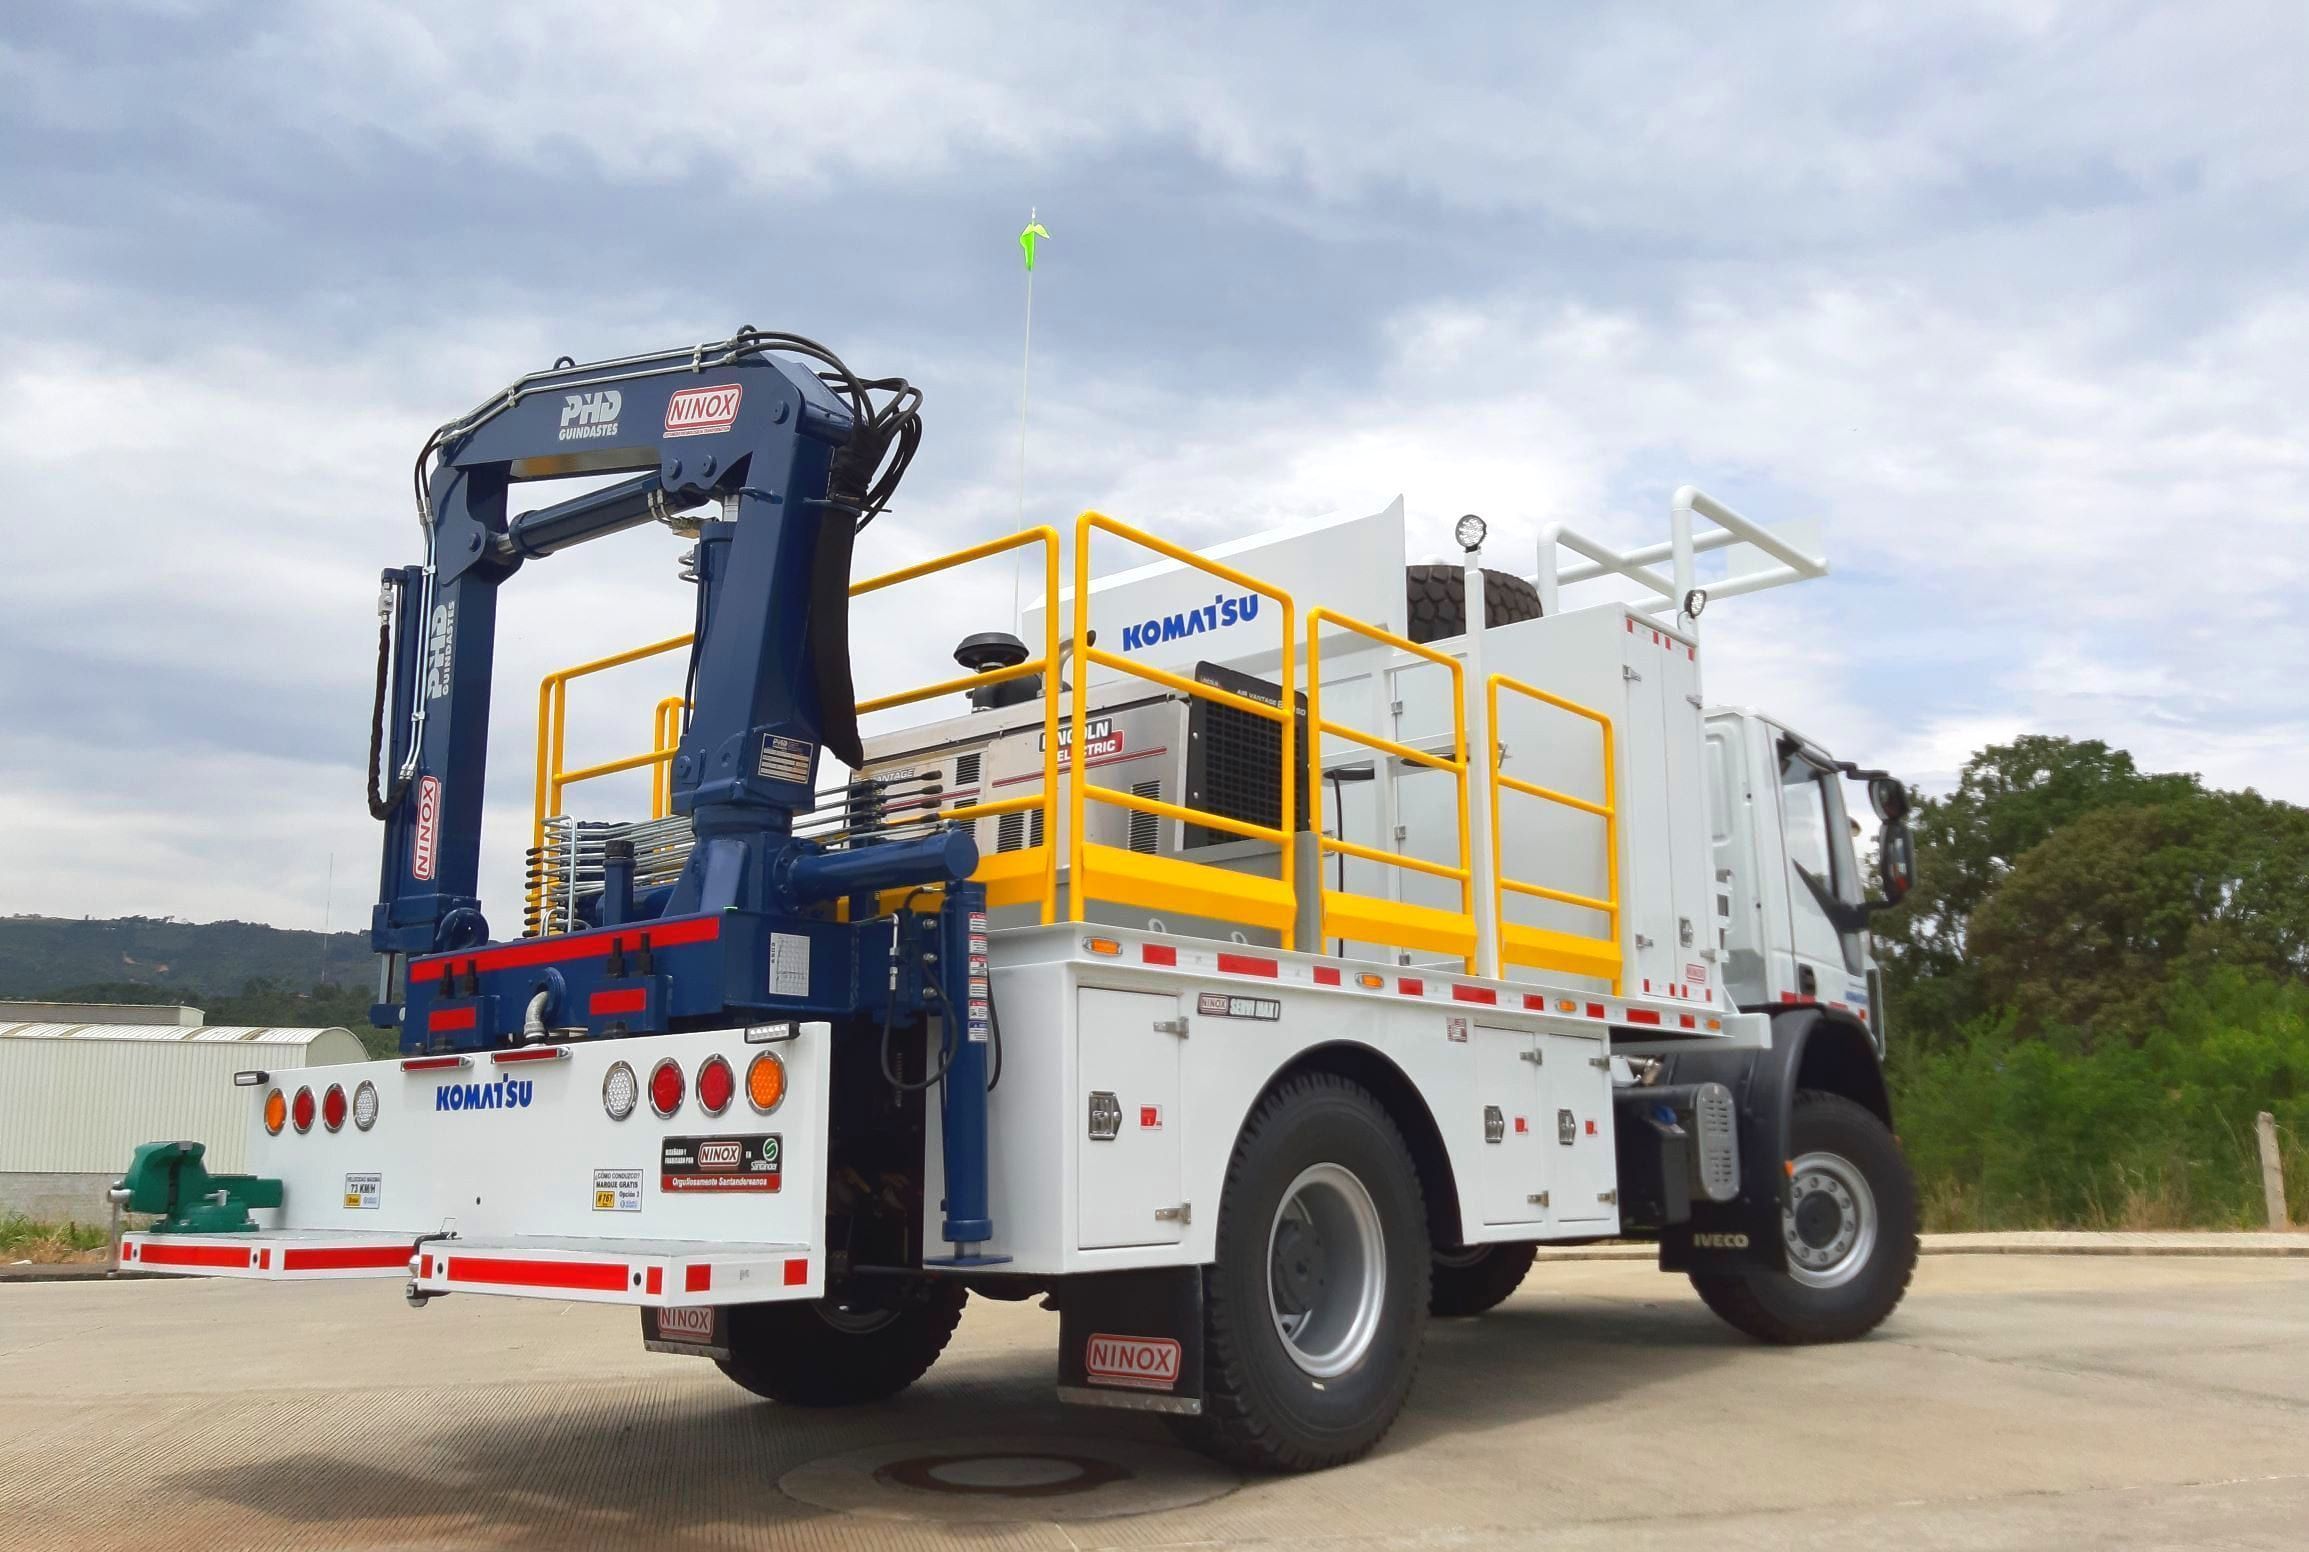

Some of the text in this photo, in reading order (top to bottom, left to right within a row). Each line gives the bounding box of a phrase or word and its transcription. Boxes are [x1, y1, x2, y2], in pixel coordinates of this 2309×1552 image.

[560, 390, 622, 427] PHD
[670, 393, 736, 421] NINOX
[558, 423, 619, 441] GUINDASTES
[1122, 594, 1259, 652] KOMATSU
[427, 604, 447, 699] PHD
[442, 600, 455, 696] GUINDASTES
[416, 784, 434, 873] NINOX
[1201, 997, 1226, 1009] NINOX
[436, 1072, 533, 1112] KOMATSU
[701, 1147, 738, 1161] NINOX
[596, 1181, 639, 1189] MARQUE GRATIS
[718, 1176, 768, 1186] Santandereanos
[1693, 1233, 1749, 1248] IVECO
[661, 1307, 710, 1331] NINOX
[1092, 1343, 1172, 1373] NINOX
